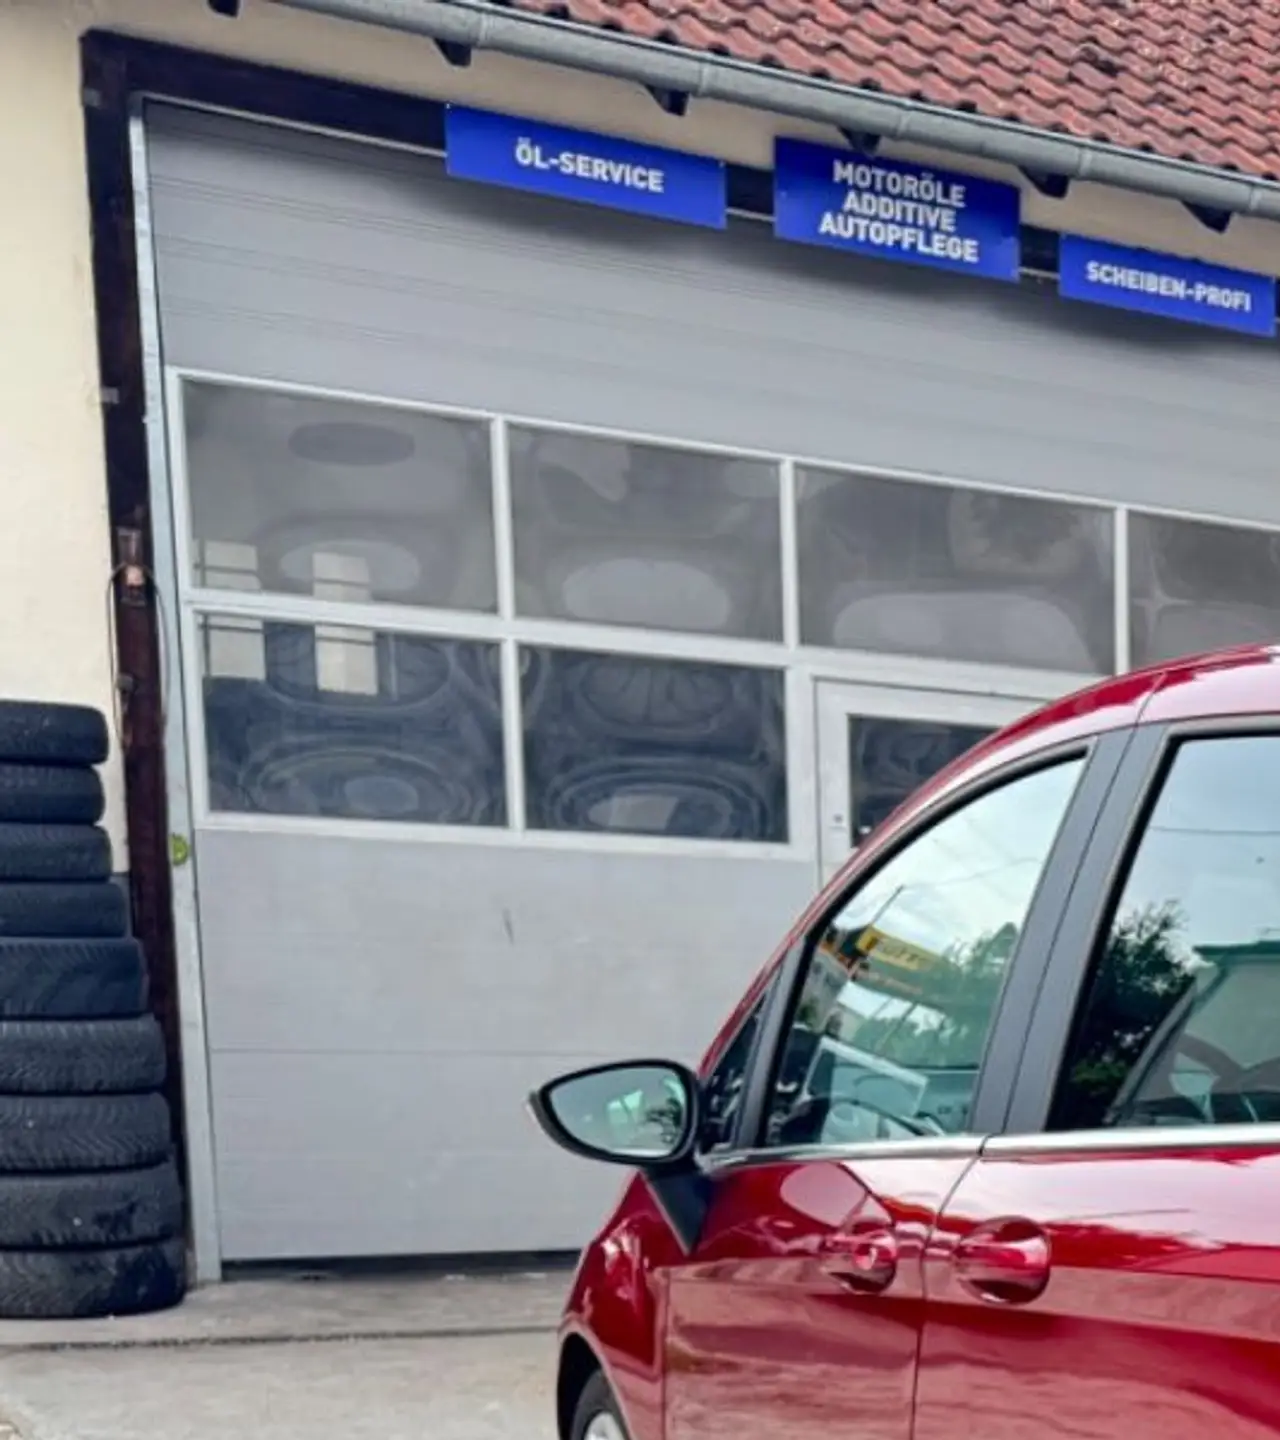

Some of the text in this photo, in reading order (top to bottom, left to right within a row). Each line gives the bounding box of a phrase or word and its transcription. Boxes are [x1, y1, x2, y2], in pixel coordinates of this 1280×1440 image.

[515, 136, 665, 193] ÖL-SERVICE
[832, 159, 967, 208] MOTORÖLE
[818, 211, 980, 263] AUTOPFLEGE
[842, 191, 957, 233] ADDITIVE
[1086, 260, 1252, 313] SCHEIBEN-PROFI
